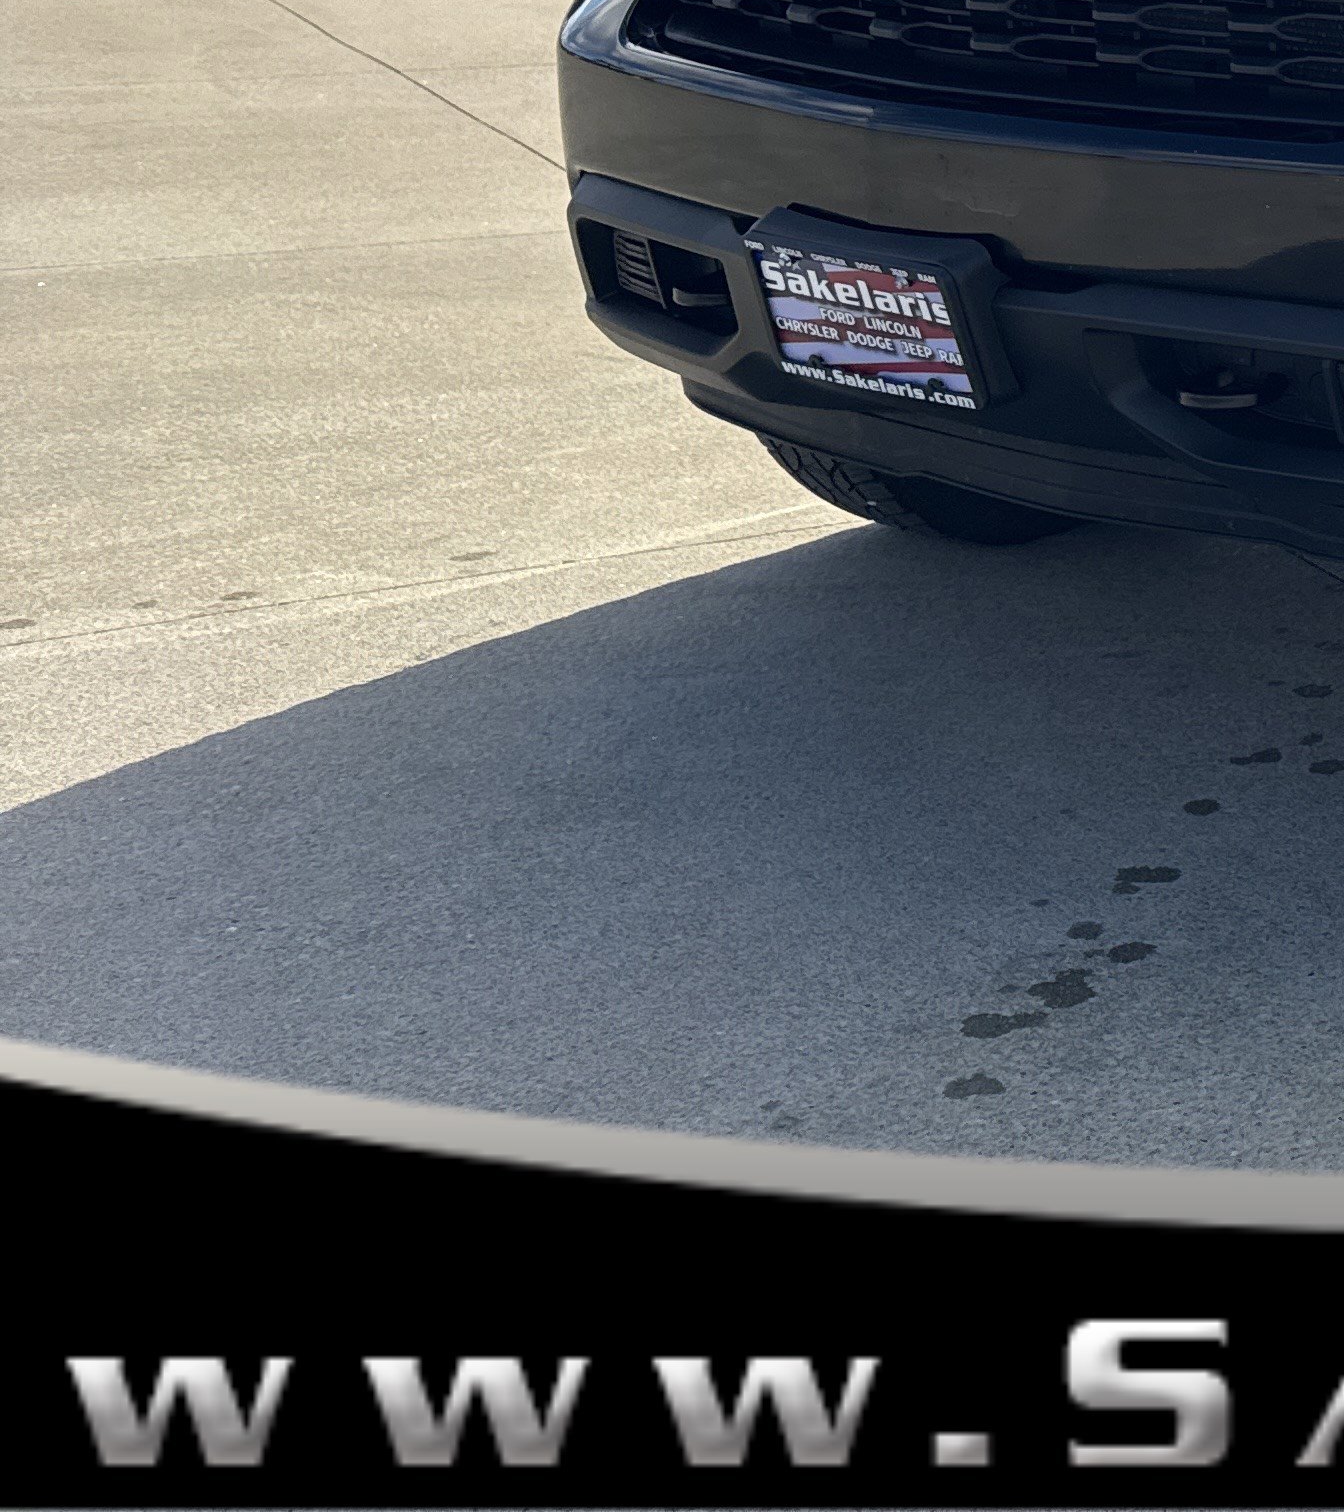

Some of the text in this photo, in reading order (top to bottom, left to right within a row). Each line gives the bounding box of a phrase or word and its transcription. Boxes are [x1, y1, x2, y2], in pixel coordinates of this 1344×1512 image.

[760, 260, 951, 326] Sakelaris
[775, 316, 840, 341] CHRYSLER
[846, 330, 895, 352] DODGE
[900, 340, 933, 359] JEEP
[819, 307, 922, 339] FORD LINCOLN
